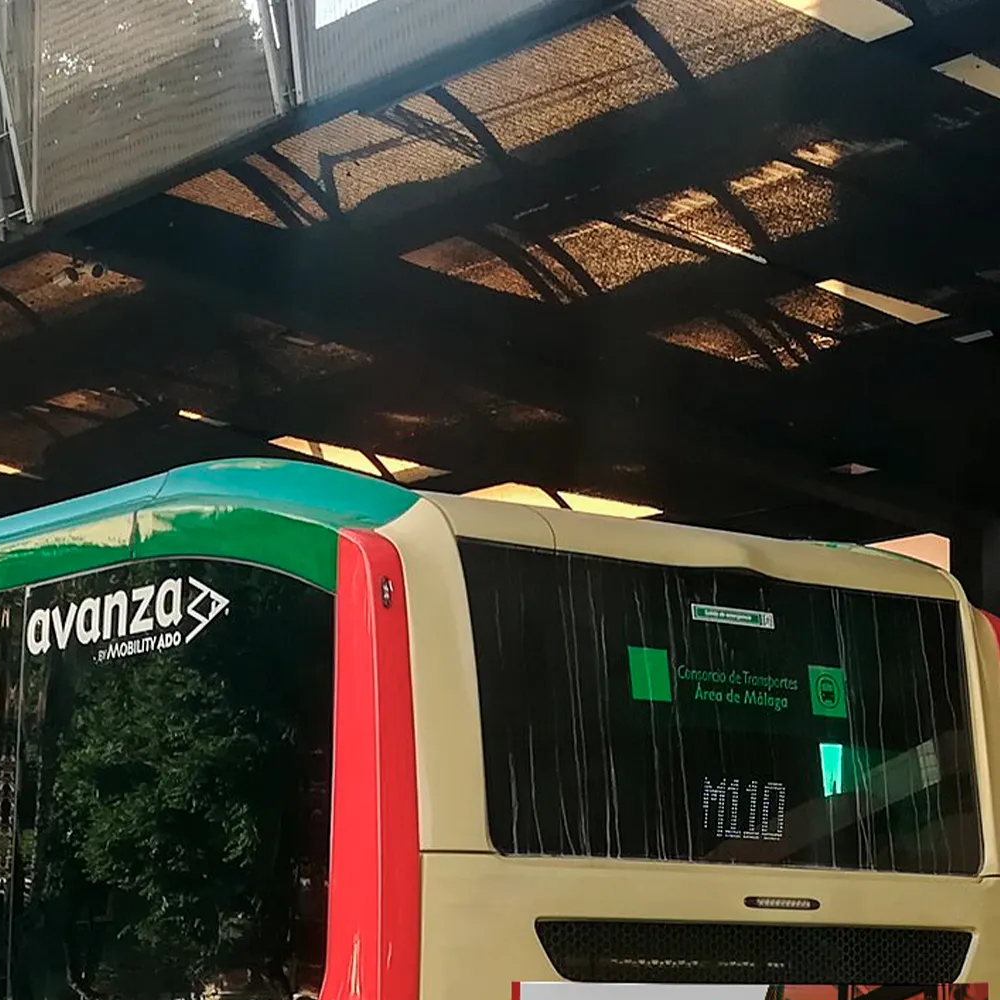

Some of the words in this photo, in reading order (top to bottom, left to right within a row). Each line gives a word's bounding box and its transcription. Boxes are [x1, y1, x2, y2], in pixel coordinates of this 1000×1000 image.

[27, 577, 183, 655] avanza
[677, 665, 726, 683] Consorcio
[729, 670, 742, 685] de
[743, 671, 799, 691] Transportes
[726, 688, 740, 704] de
[744, 690, 789, 711] Málaga
